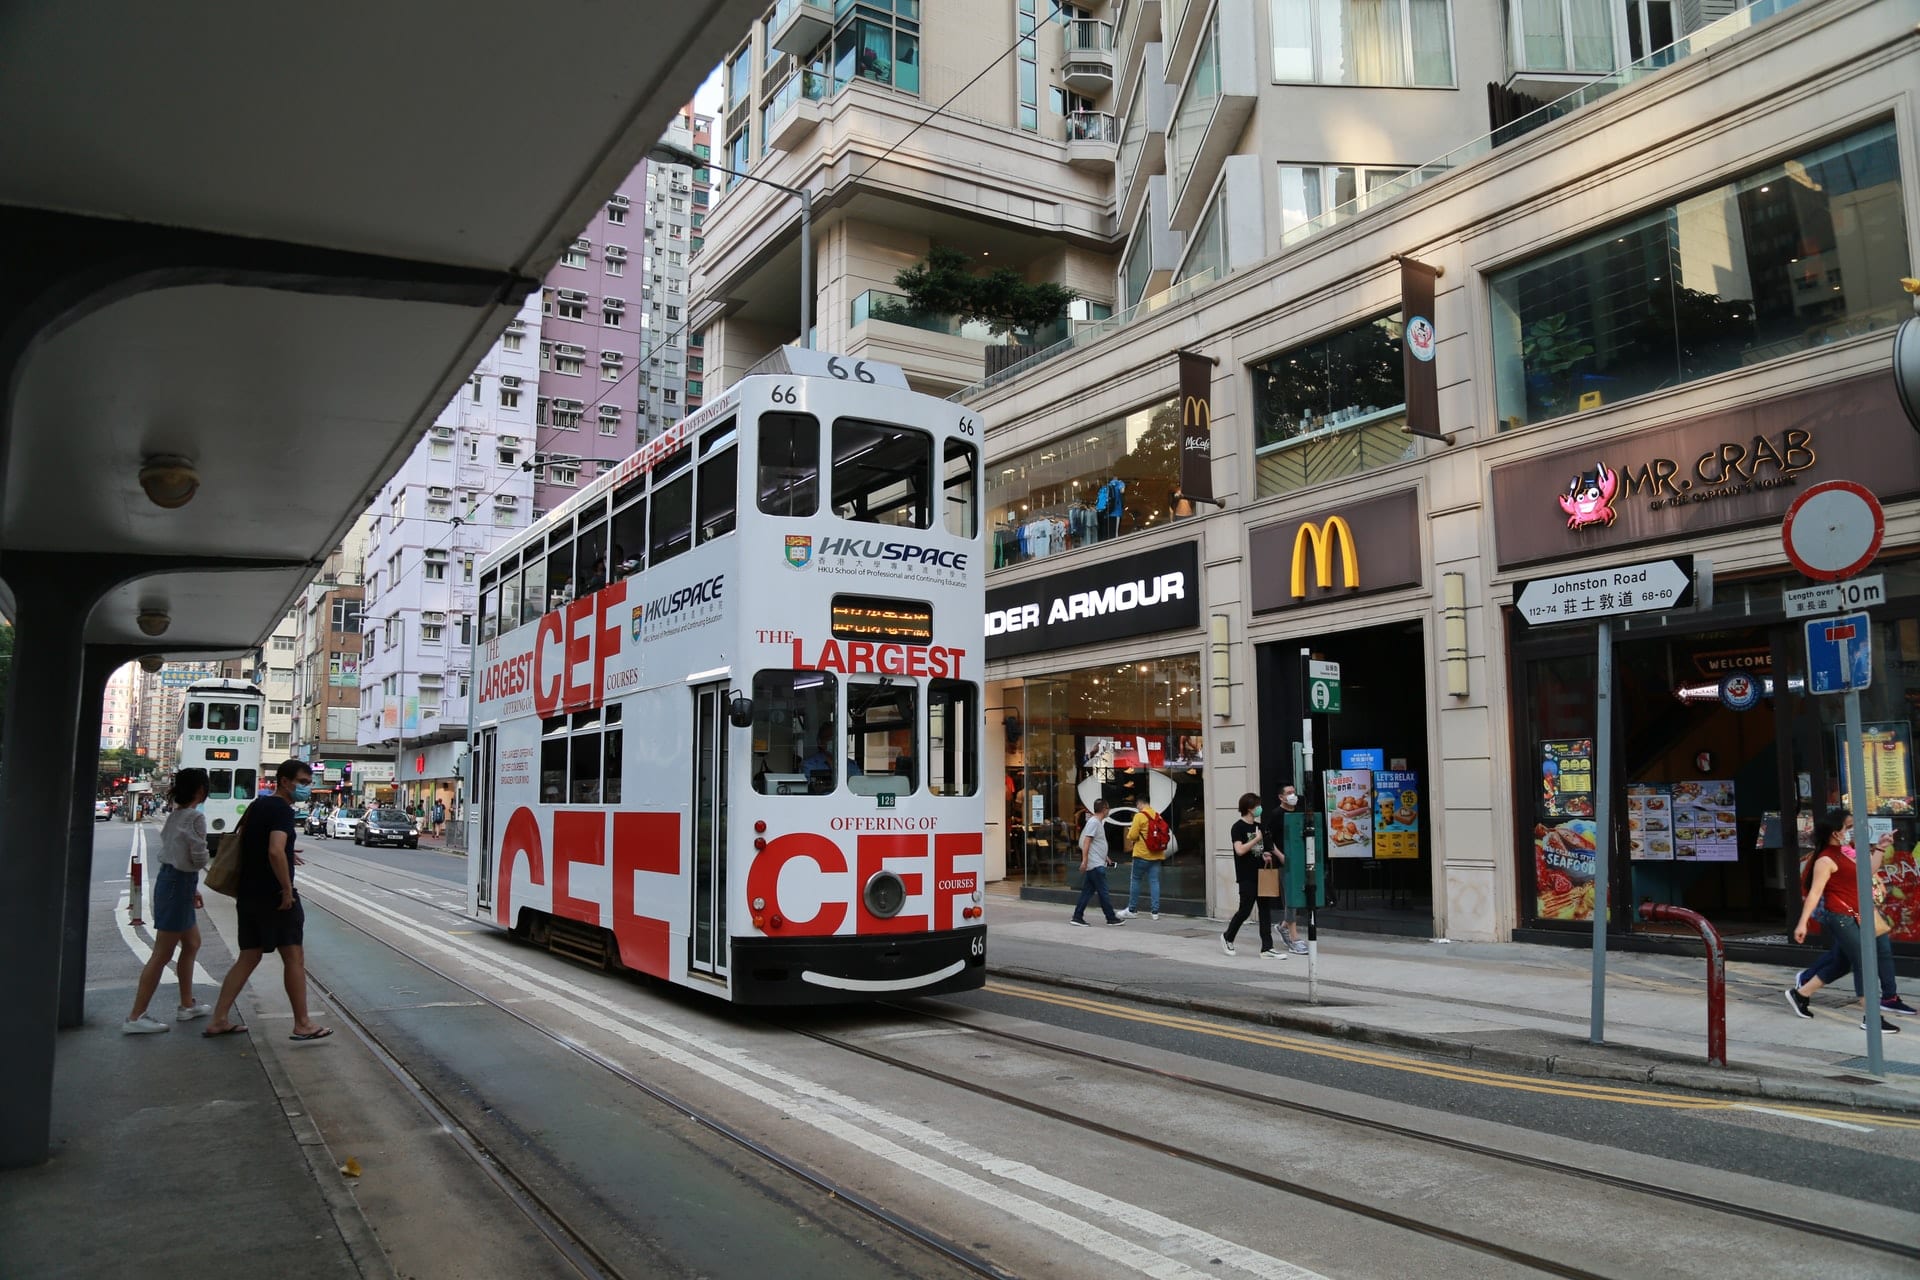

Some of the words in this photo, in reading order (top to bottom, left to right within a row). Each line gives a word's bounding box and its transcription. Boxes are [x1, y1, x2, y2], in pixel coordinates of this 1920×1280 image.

[827, 356, 875, 384] 66
[771, 385, 797, 404] 66
[959, 416, 975, 437] 66
[1699, 429, 1816, 485] CRAB
[835, 567, 857, 576] School
[866, 570, 902, 579] Professional
[916, 574, 945, 586] Continuing
[945, 578, 968, 588] Education
[1552, 577, 1607, 595] Johnston
[1614, 570, 1647, 585] Road
[1047, 571, 1185, 625] ARMOUR
[1529, 605, 1557, 616] 112-74
[1563, 591, 1633, 614] 莊士敦道
[1642, 589, 1673, 601] 68-60
[1788, 590, 1814, 601] Length
[1816, 588, 1834, 597] over
[478, 650, 534, 704] LARGEST
[533, 578, 627, 721] CEF
[485, 637, 500, 662] THE
[755, 630, 794, 644] THE
[792, 638, 966, 680] LARGEST
[1708, 655, 1773, 670] WELCOME
[606, 667, 640, 691] COURSES
[1395, 773, 1415, 781] RELAX
[881, 796, 894, 806] 128
[830, 816, 916, 831] OFFERING
[918, 816, 938, 830] OF
[1546, 853, 1596, 875] SEAFOOD
[746, 832, 983, 937] CEF
[938, 878, 974, 890] COURSES
[971, 935, 984, 956] 66
